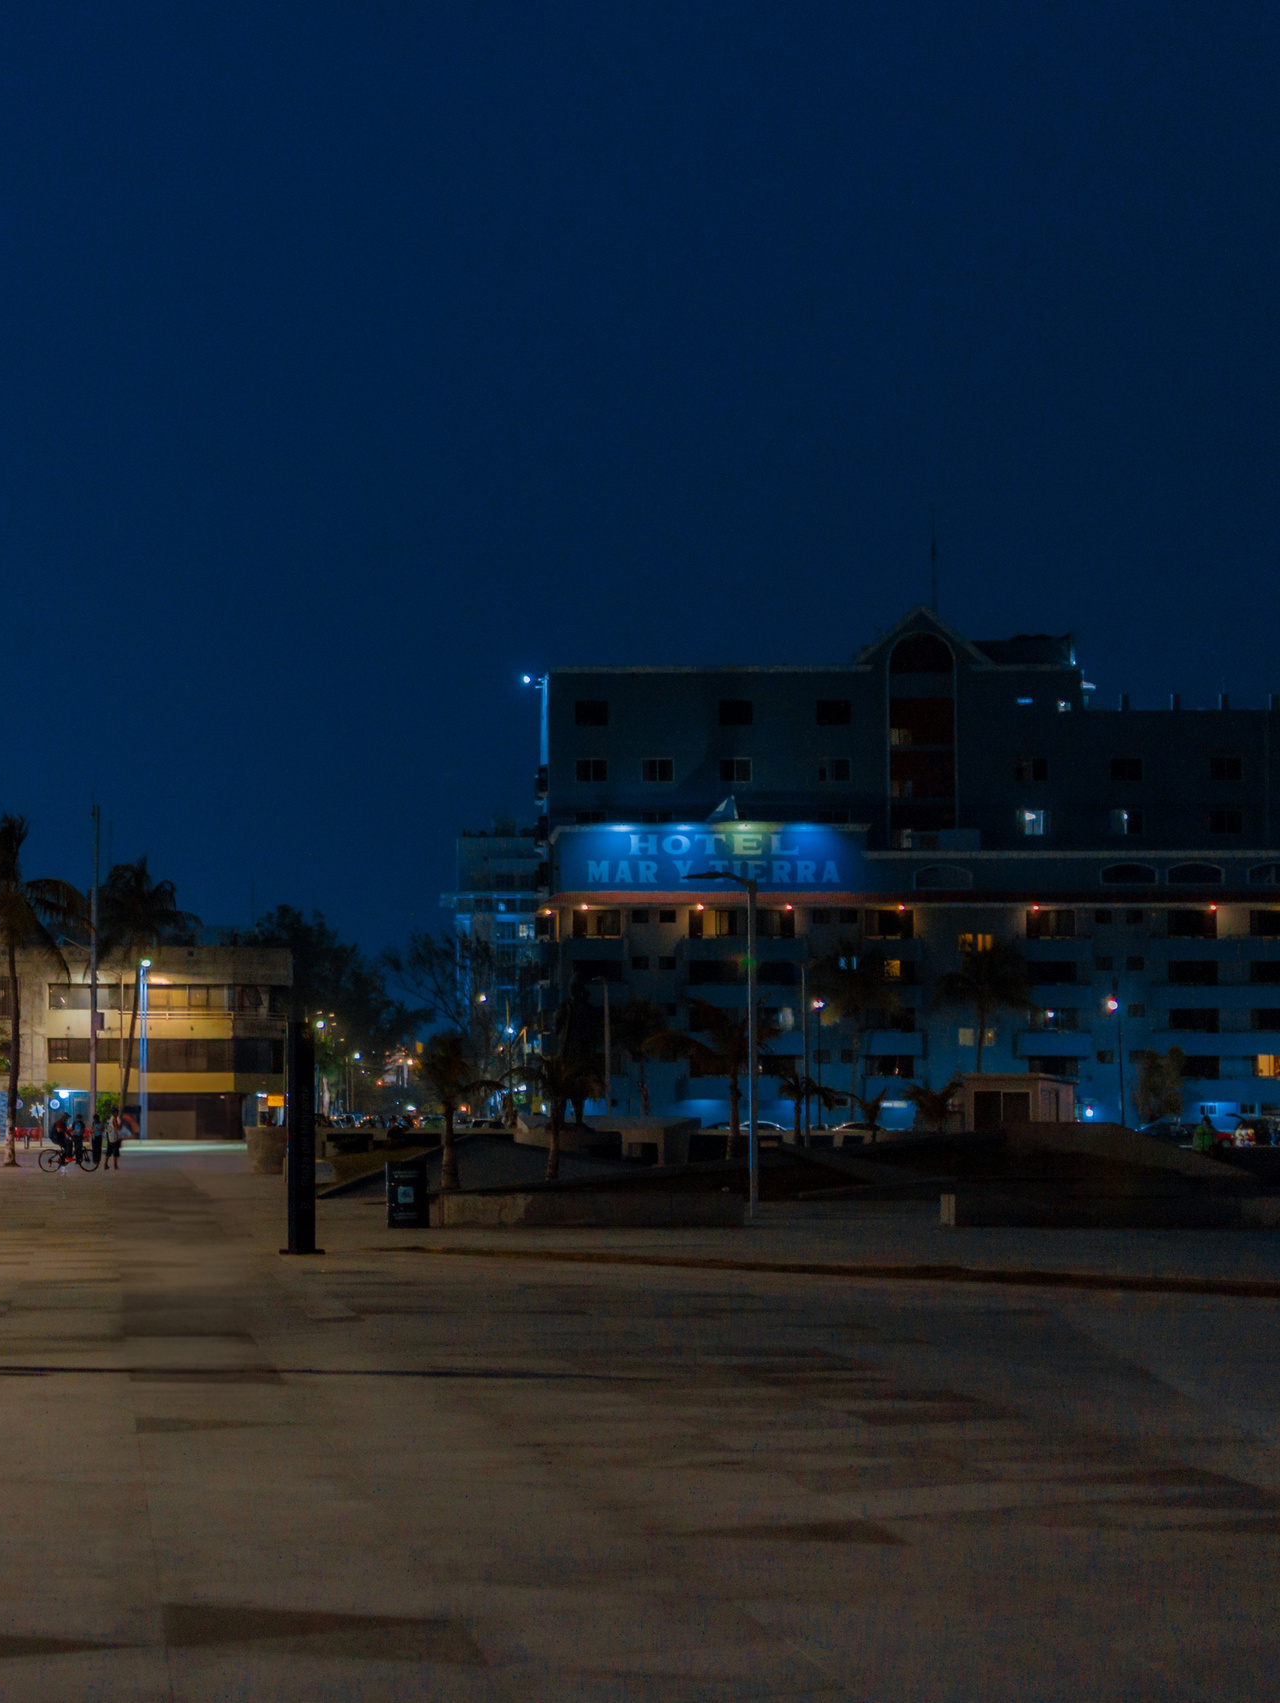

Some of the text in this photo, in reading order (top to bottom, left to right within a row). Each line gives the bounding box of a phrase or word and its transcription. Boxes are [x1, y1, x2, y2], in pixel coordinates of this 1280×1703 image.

[629, 834, 799, 856] HOTEL
[587, 859, 841, 883] MAR Y TIERRA
